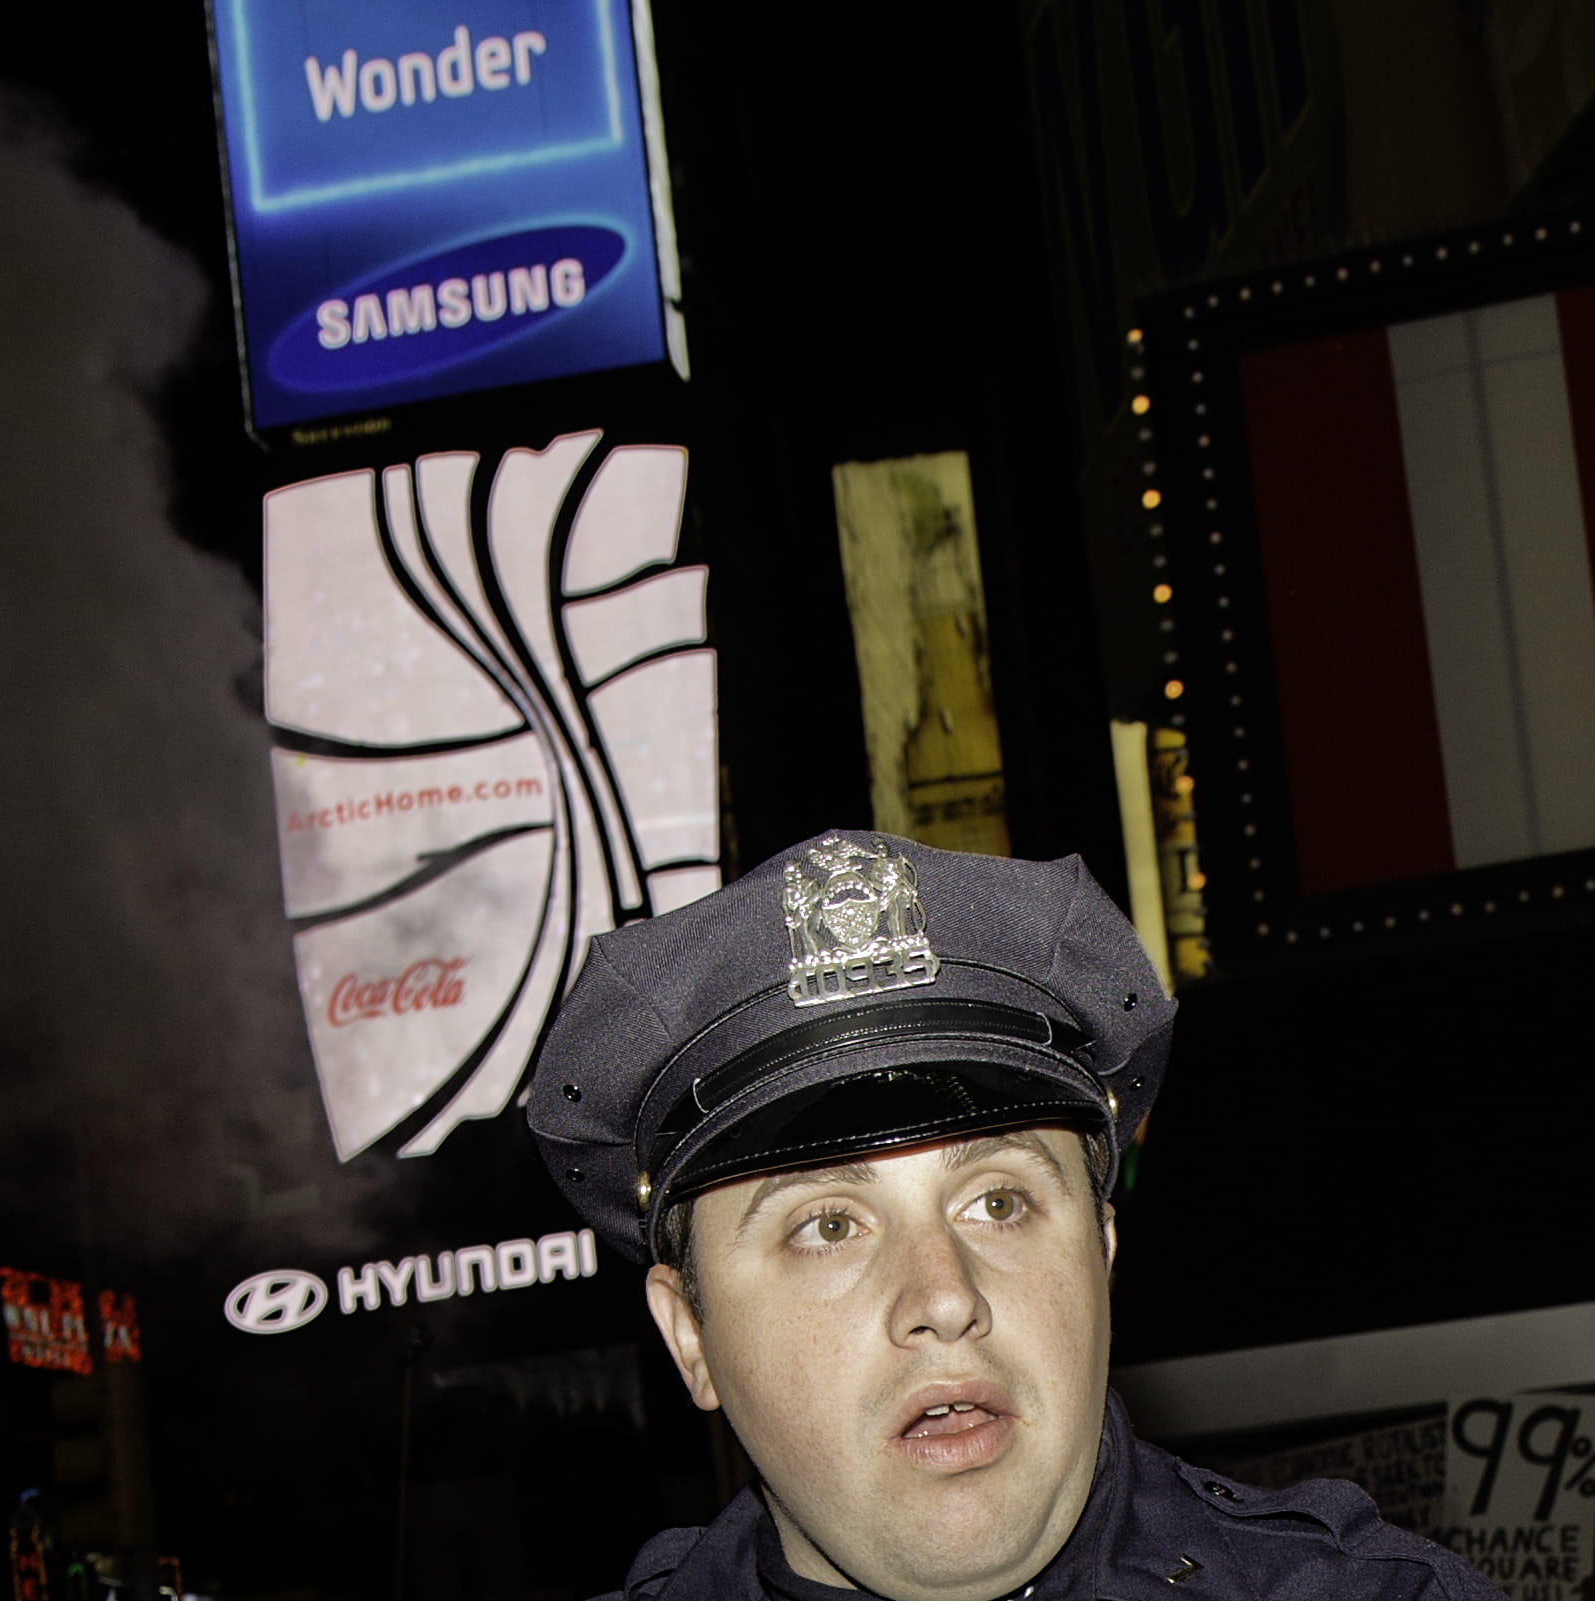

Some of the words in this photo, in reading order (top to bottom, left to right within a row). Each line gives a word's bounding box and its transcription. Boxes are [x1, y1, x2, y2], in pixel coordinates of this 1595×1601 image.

[305, 25, 546, 123] Wonder
[316, 257, 585, 350] SAMSUNG
[285, 776, 544, 833] ArcticHome.com
[797, 950, 936, 1001] 10935
[337, 1228, 598, 1315] HYUNDAI
[1471, 1555, 1516, 1580] OU
